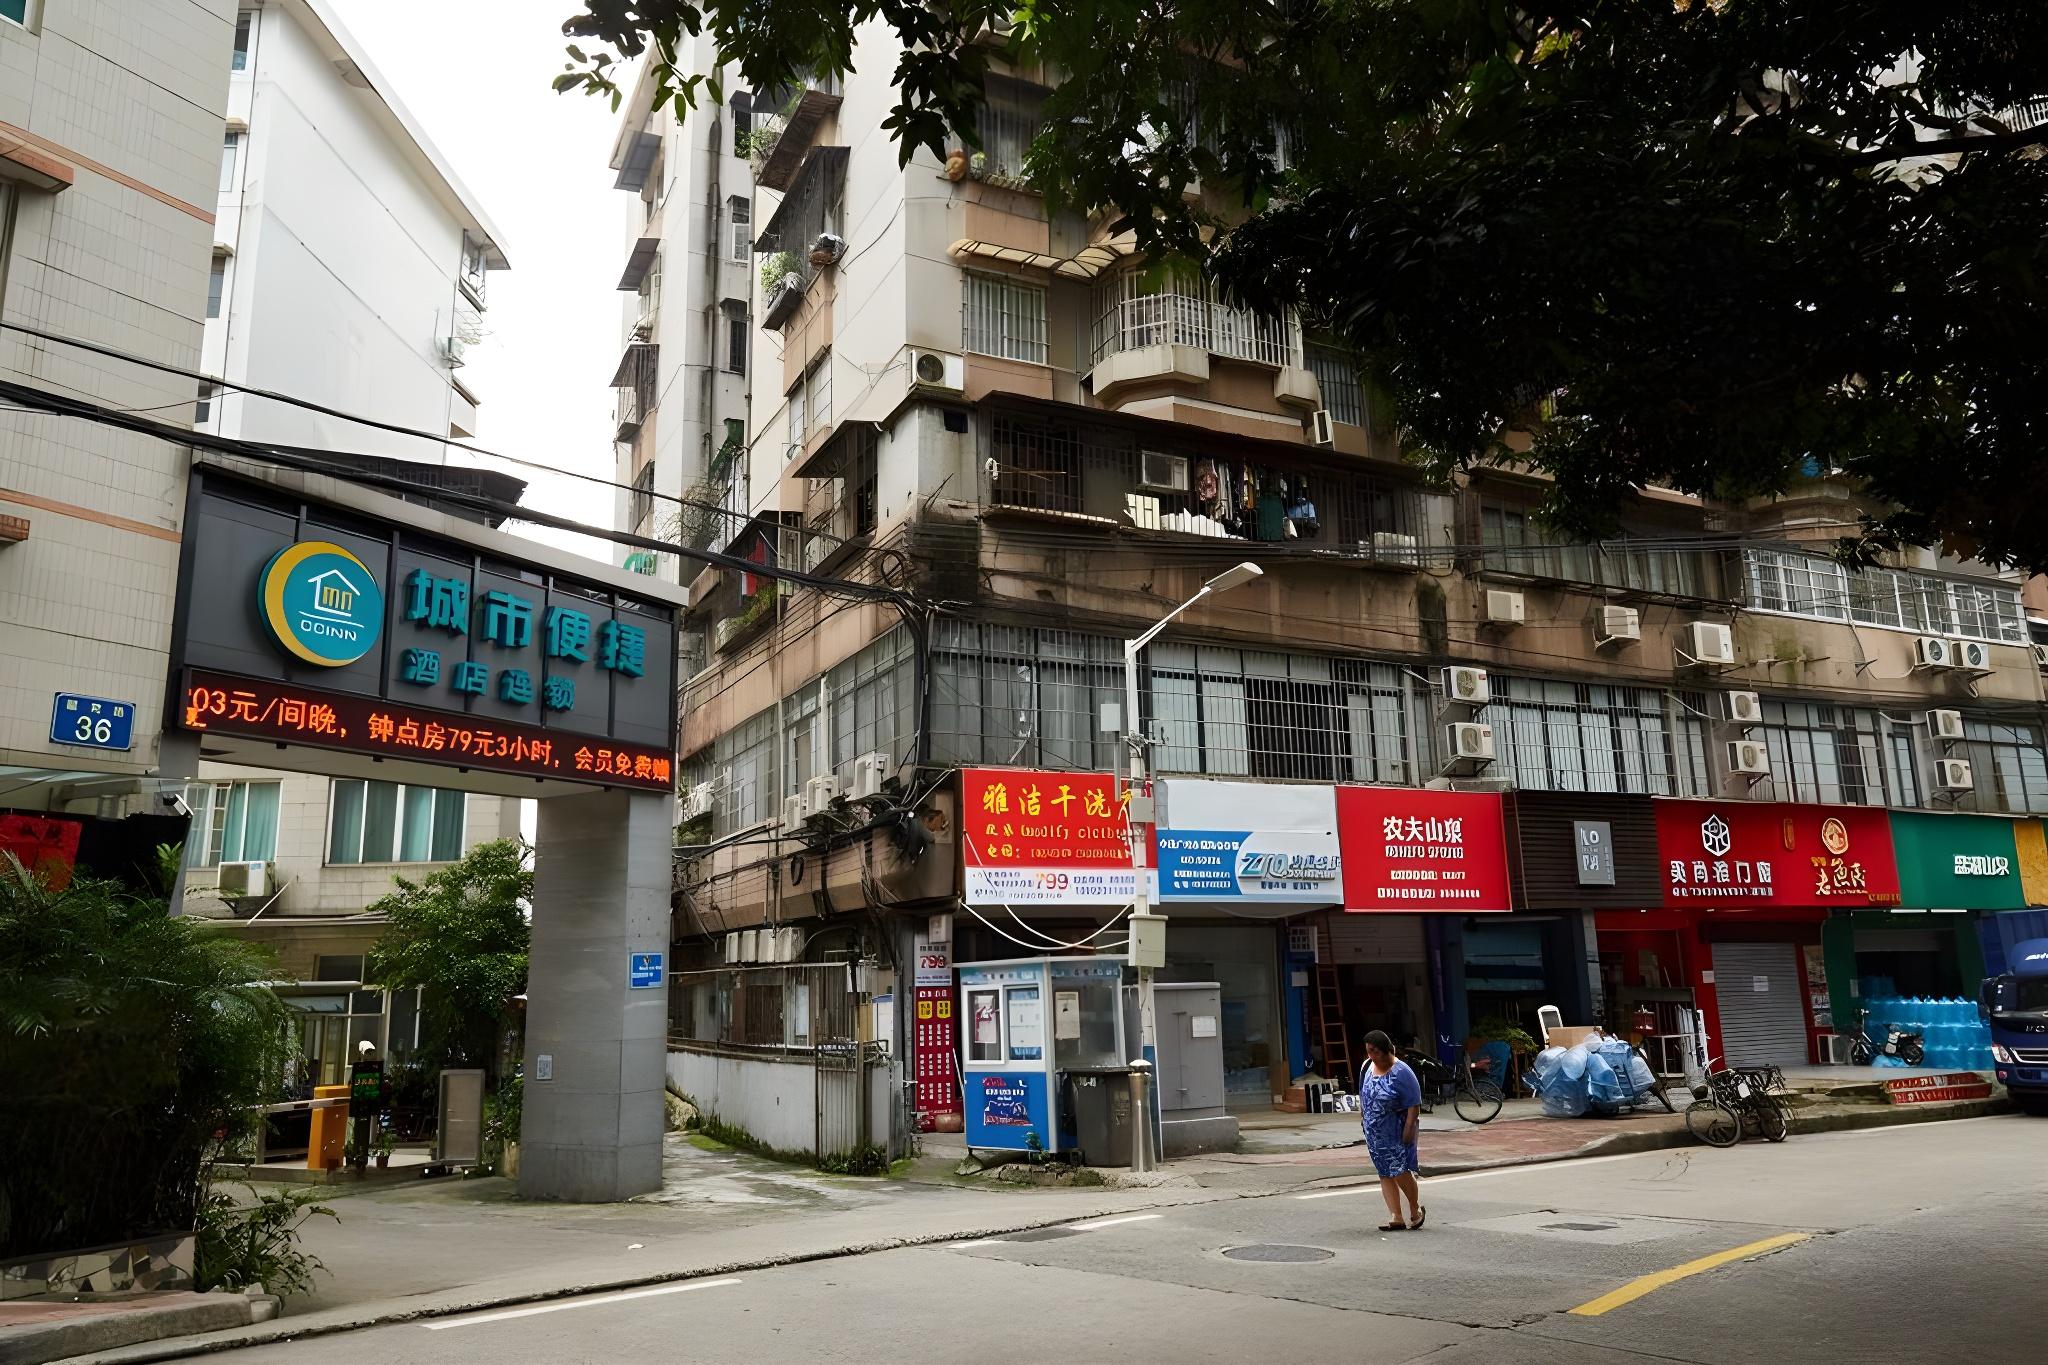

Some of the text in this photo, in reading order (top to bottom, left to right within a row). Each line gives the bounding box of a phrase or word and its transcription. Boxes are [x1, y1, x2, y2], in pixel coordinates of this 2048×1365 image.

[407, 568, 647, 678] 城市便捷
[75, 715, 112, 743] 36
